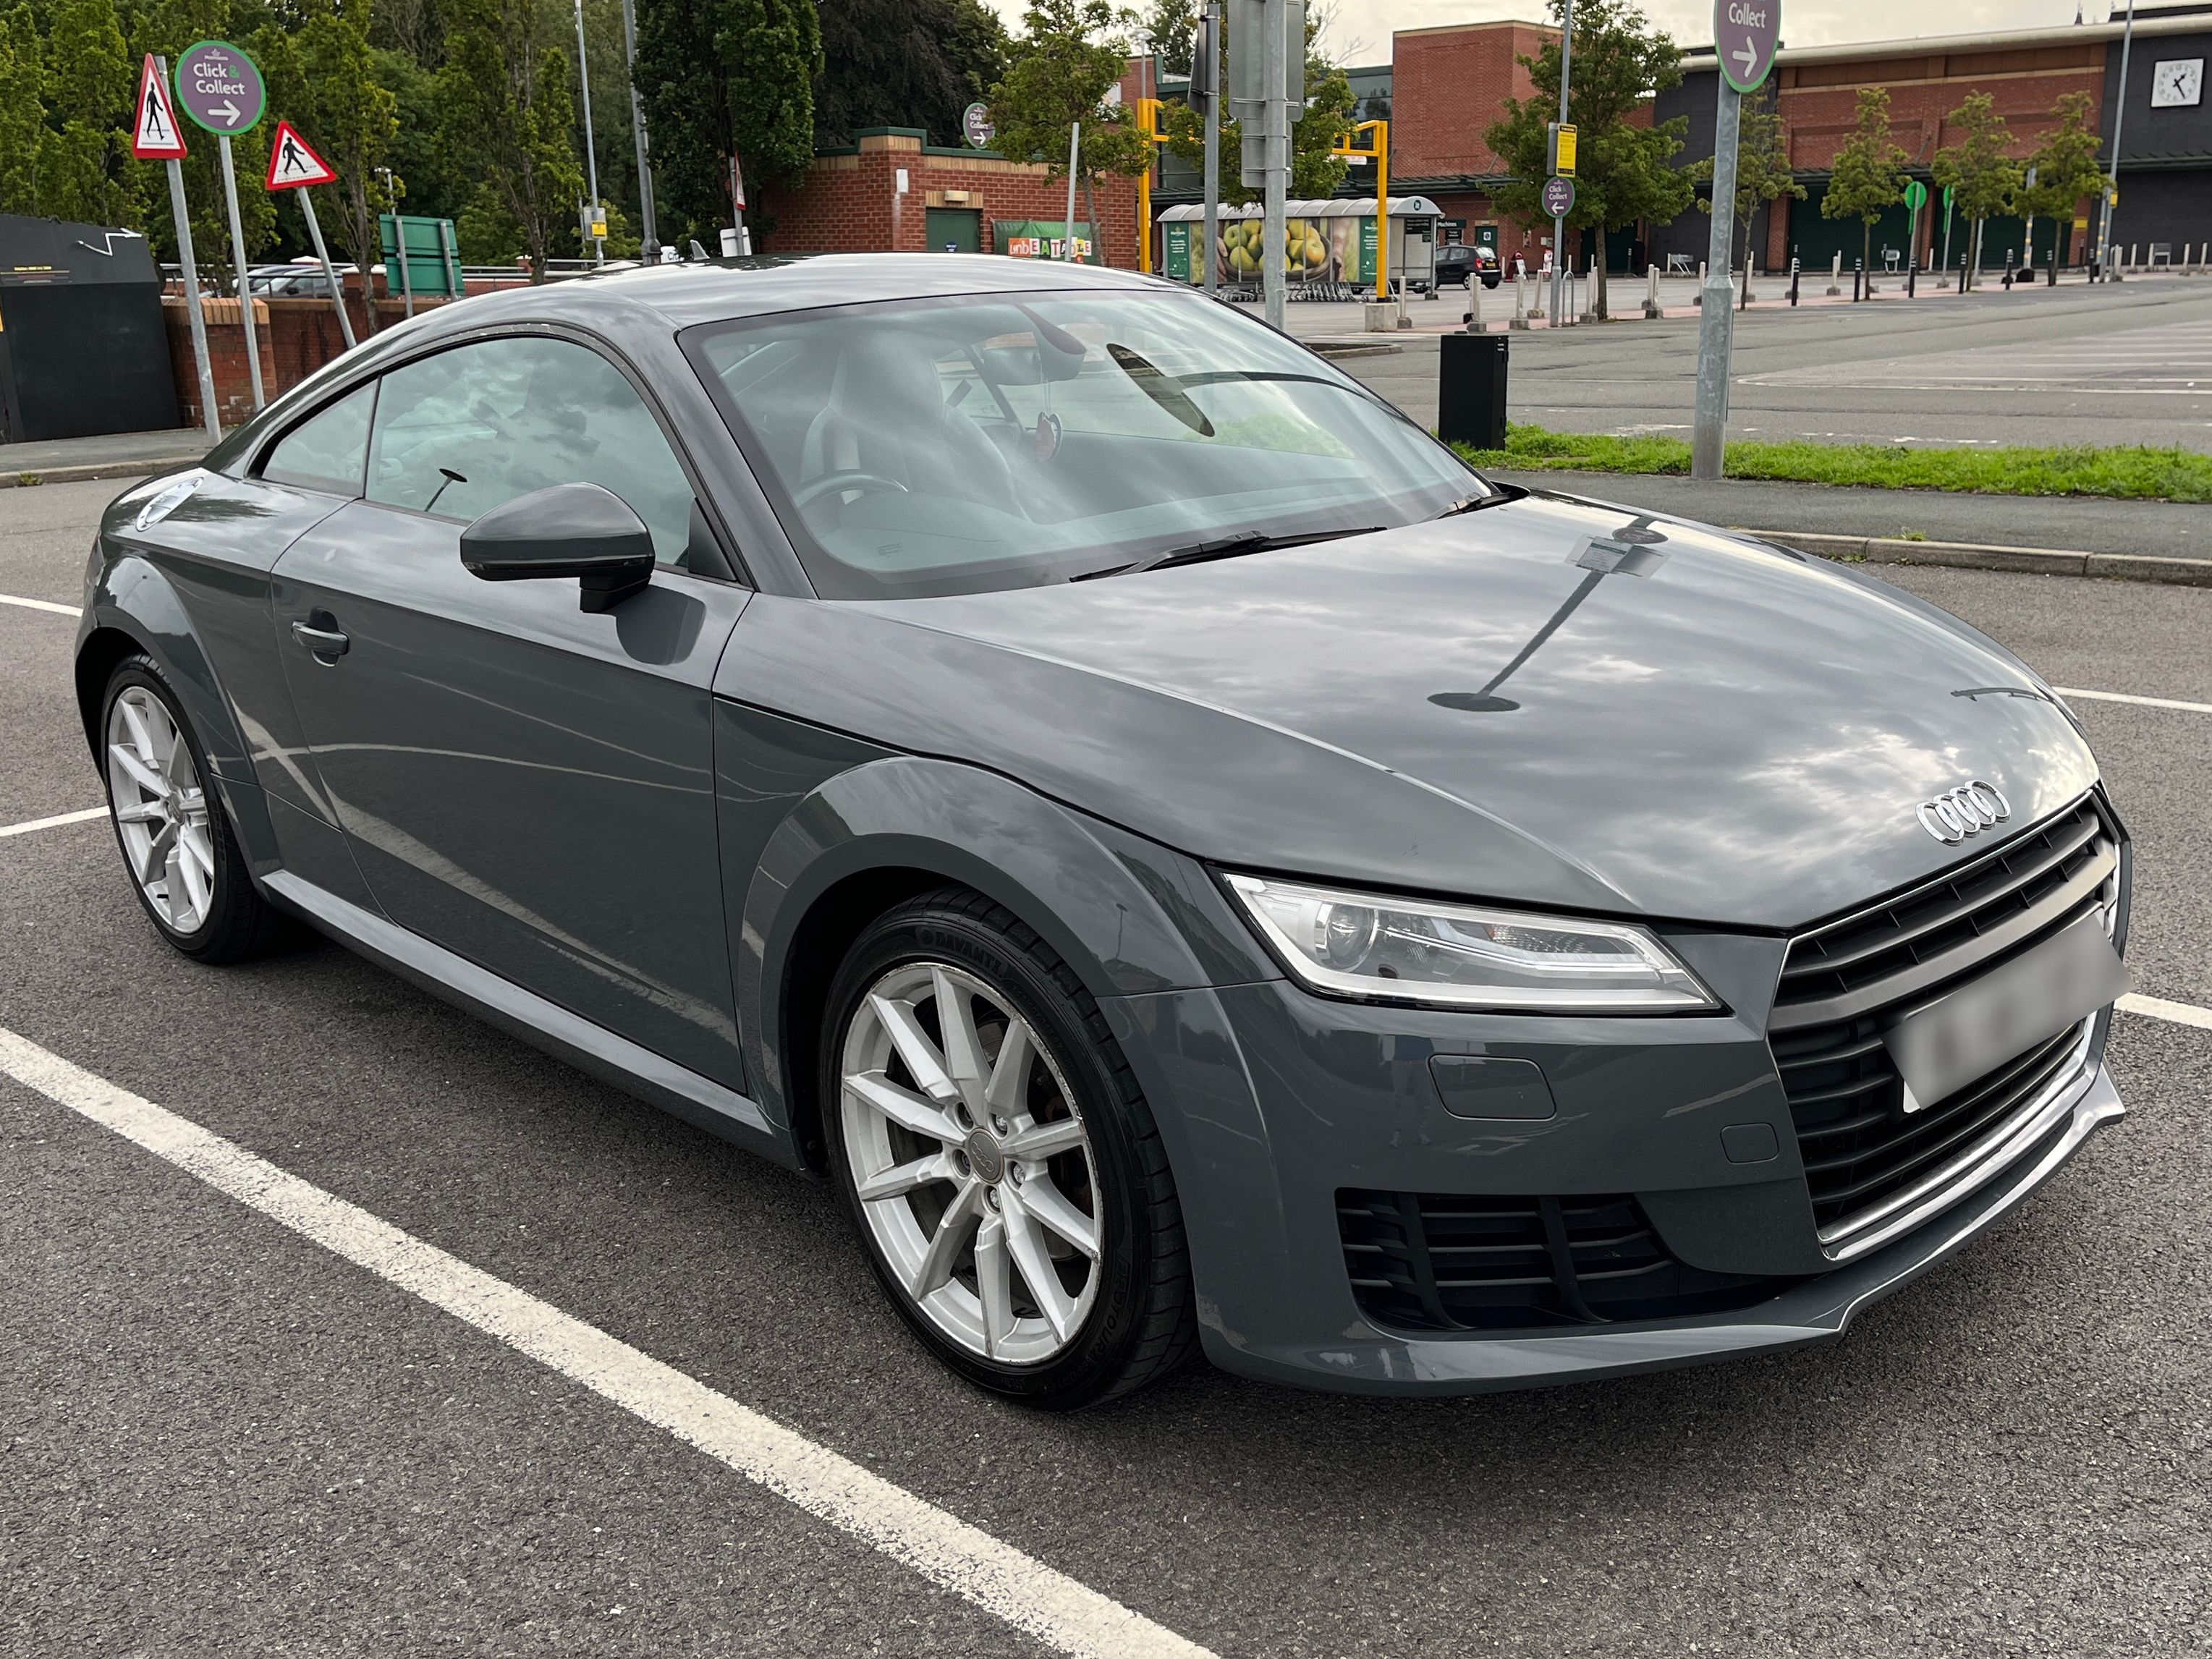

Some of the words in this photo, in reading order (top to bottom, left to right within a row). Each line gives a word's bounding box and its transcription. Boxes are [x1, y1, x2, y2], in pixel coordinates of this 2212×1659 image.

[1729, 2, 1766, 28] Collect
[193, 62, 227, 78] Click
[229, 64, 240, 78] &
[195, 80, 245, 95] Collect
